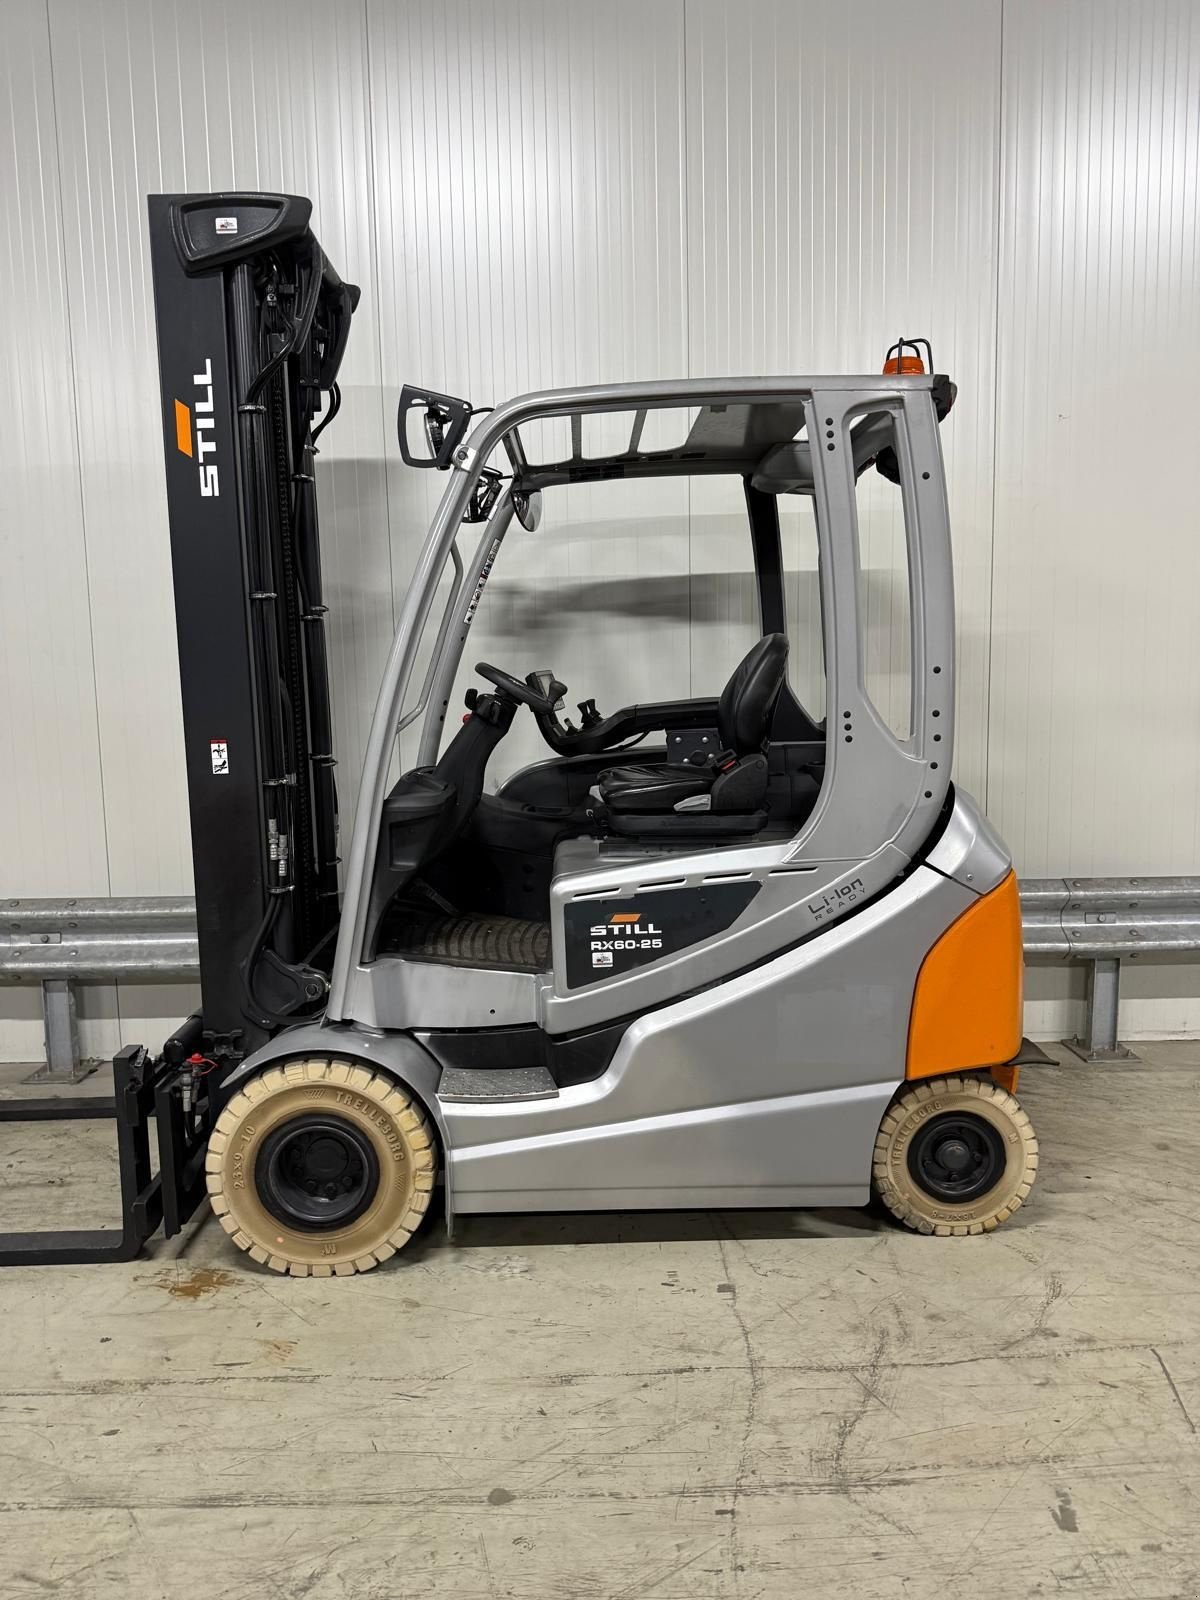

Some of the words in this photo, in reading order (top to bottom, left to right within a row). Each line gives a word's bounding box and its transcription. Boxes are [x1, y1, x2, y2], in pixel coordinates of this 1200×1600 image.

[193, 358, 220, 497] STILL
[807, 877, 864, 914] Li-Ion
[814, 887, 866, 920] READY
[590, 923, 662, 935] STILL
[590, 938, 662, 950] RX60-25
[335, 1090, 405, 1162] TRELLEBORG
[891, 1102, 943, 1166] TRELLEBORG
